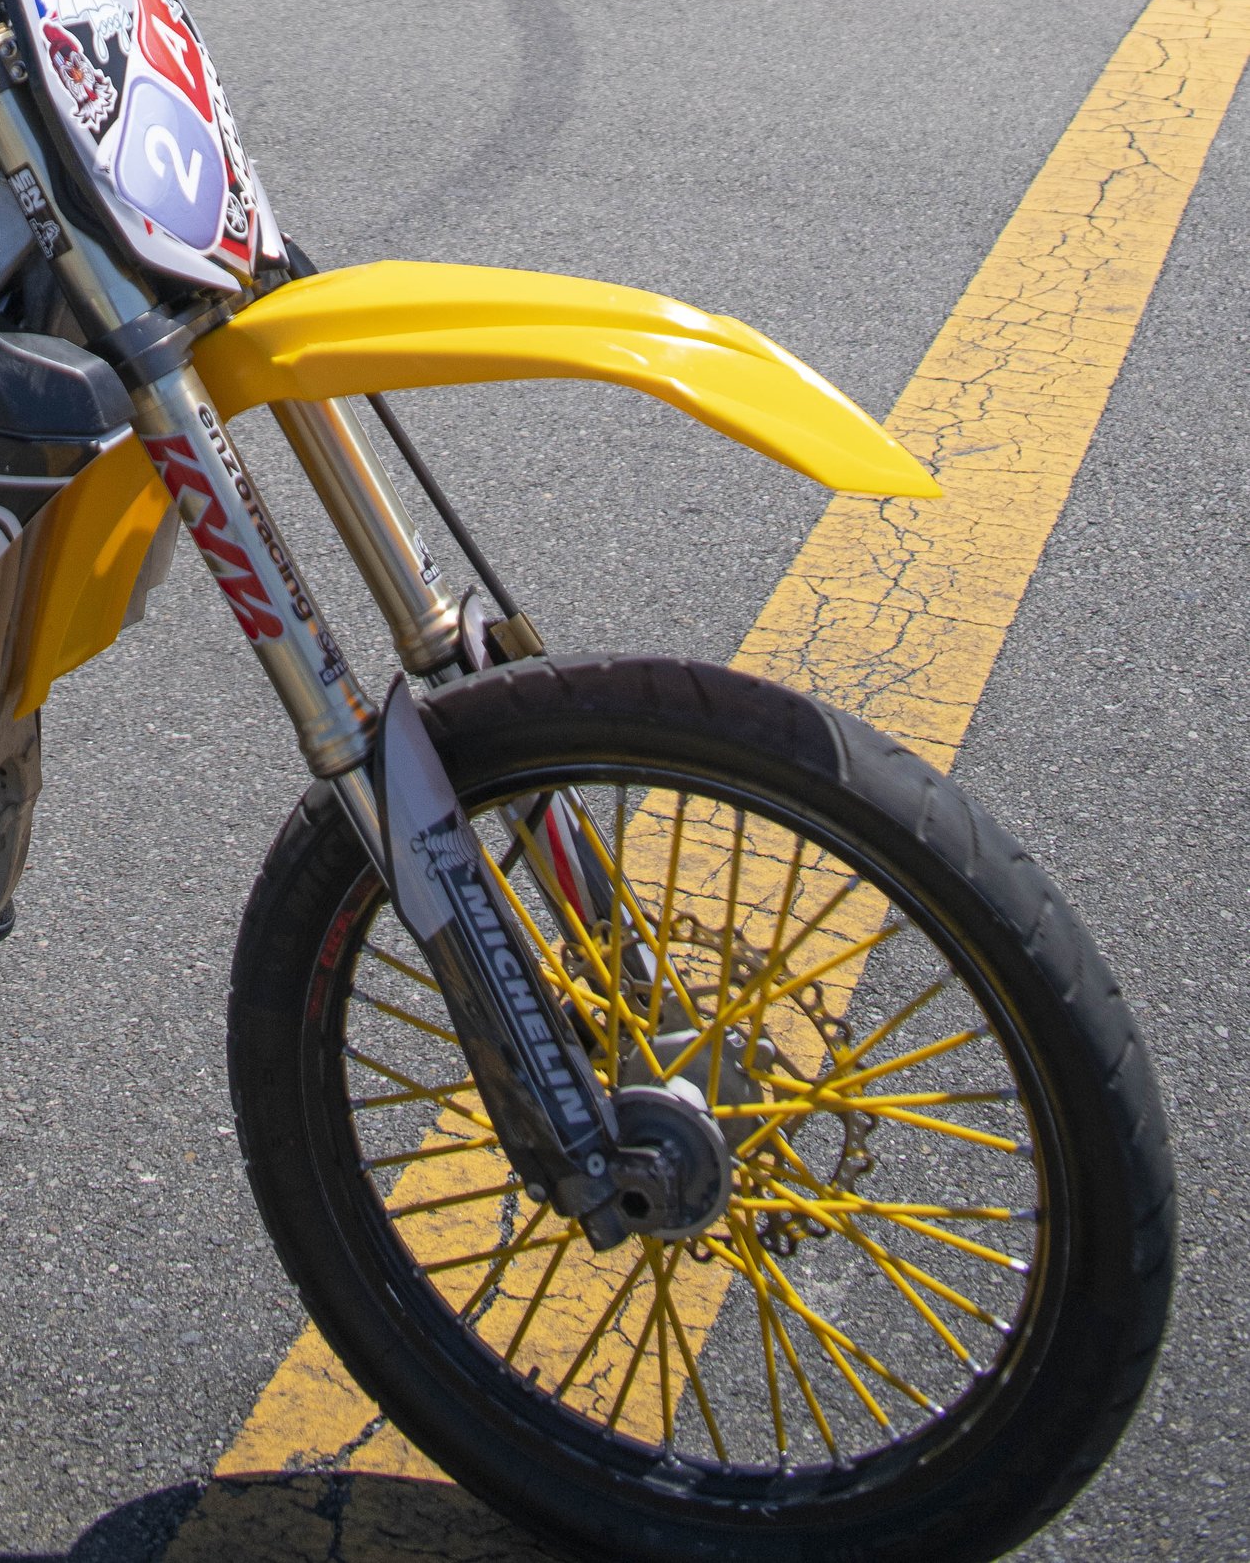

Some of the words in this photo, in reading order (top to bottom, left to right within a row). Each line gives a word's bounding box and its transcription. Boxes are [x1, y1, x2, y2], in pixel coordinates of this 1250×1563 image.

[143, 123, 202, 204] 2
[142, 434, 284, 640] KYB
[460, 883, 592, 1125] MICHELIN
